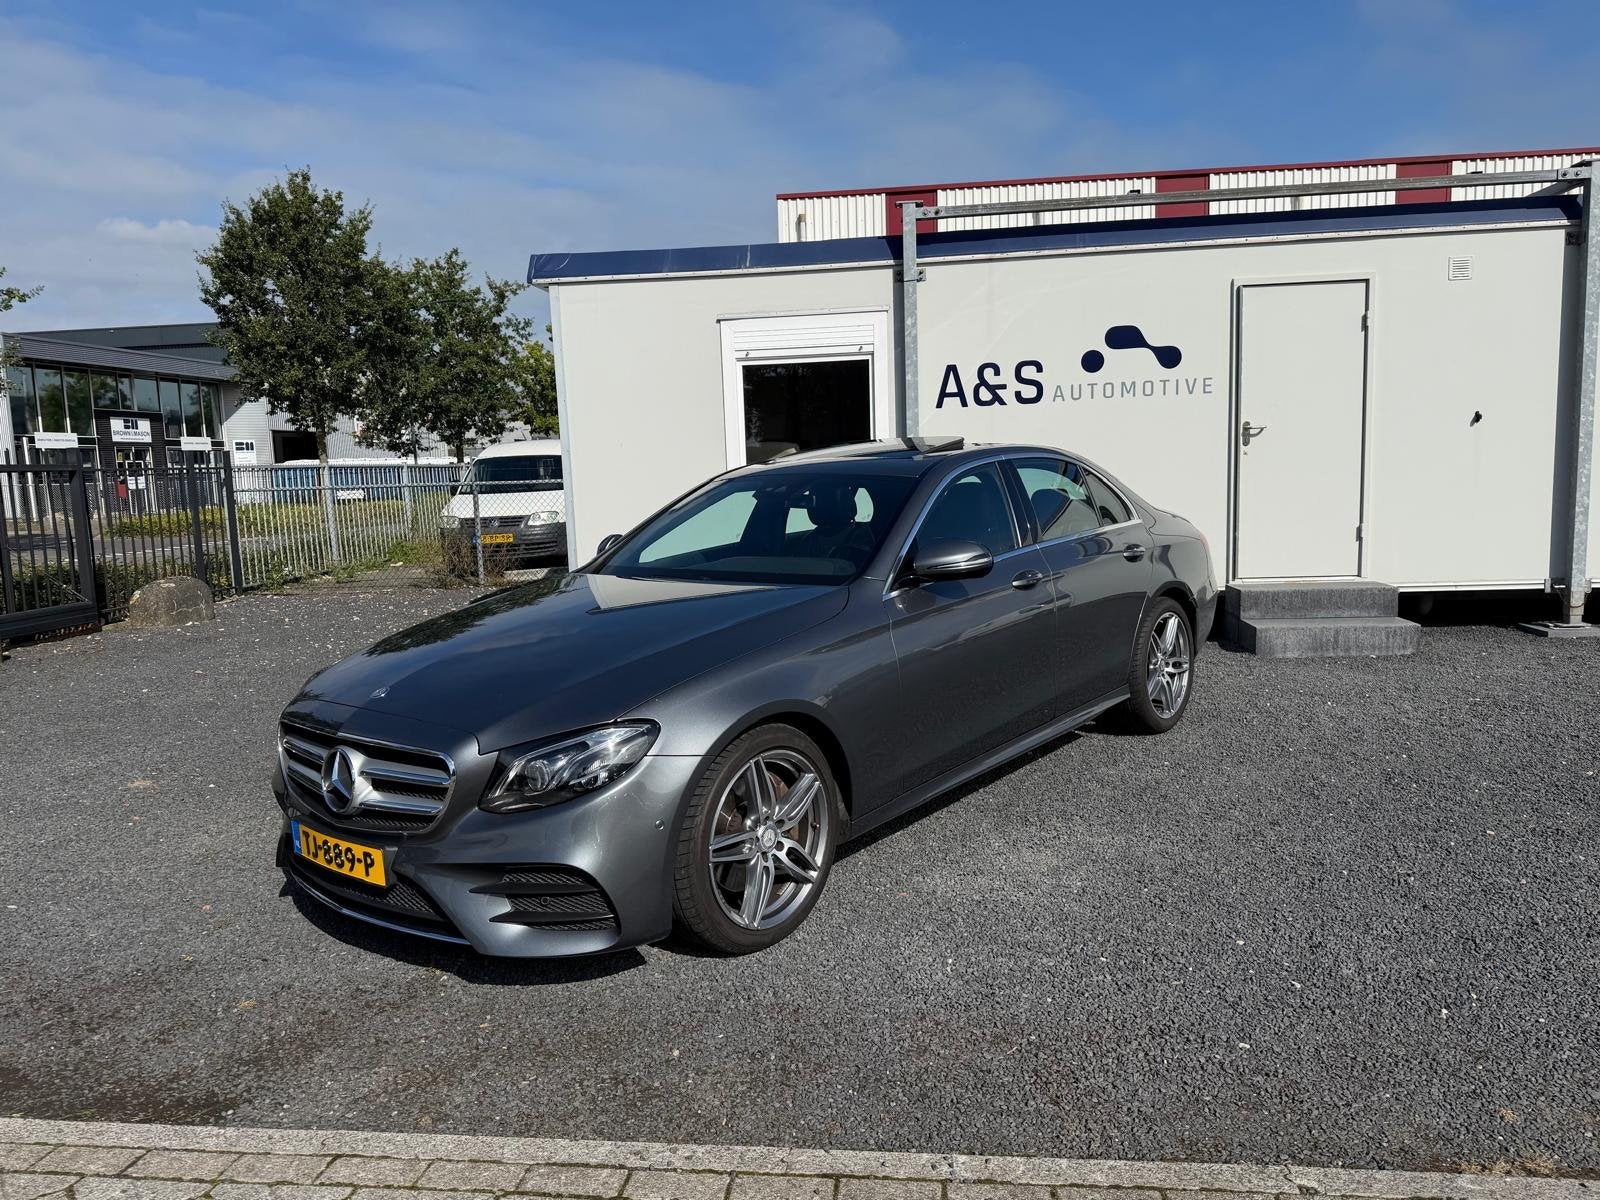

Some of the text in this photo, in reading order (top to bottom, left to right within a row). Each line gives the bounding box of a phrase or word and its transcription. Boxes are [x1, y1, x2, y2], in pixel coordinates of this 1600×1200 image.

[936, 359, 1214, 409] A&S AUTOMOTIVE
[302, 830, 375, 877] TJ-889-P
